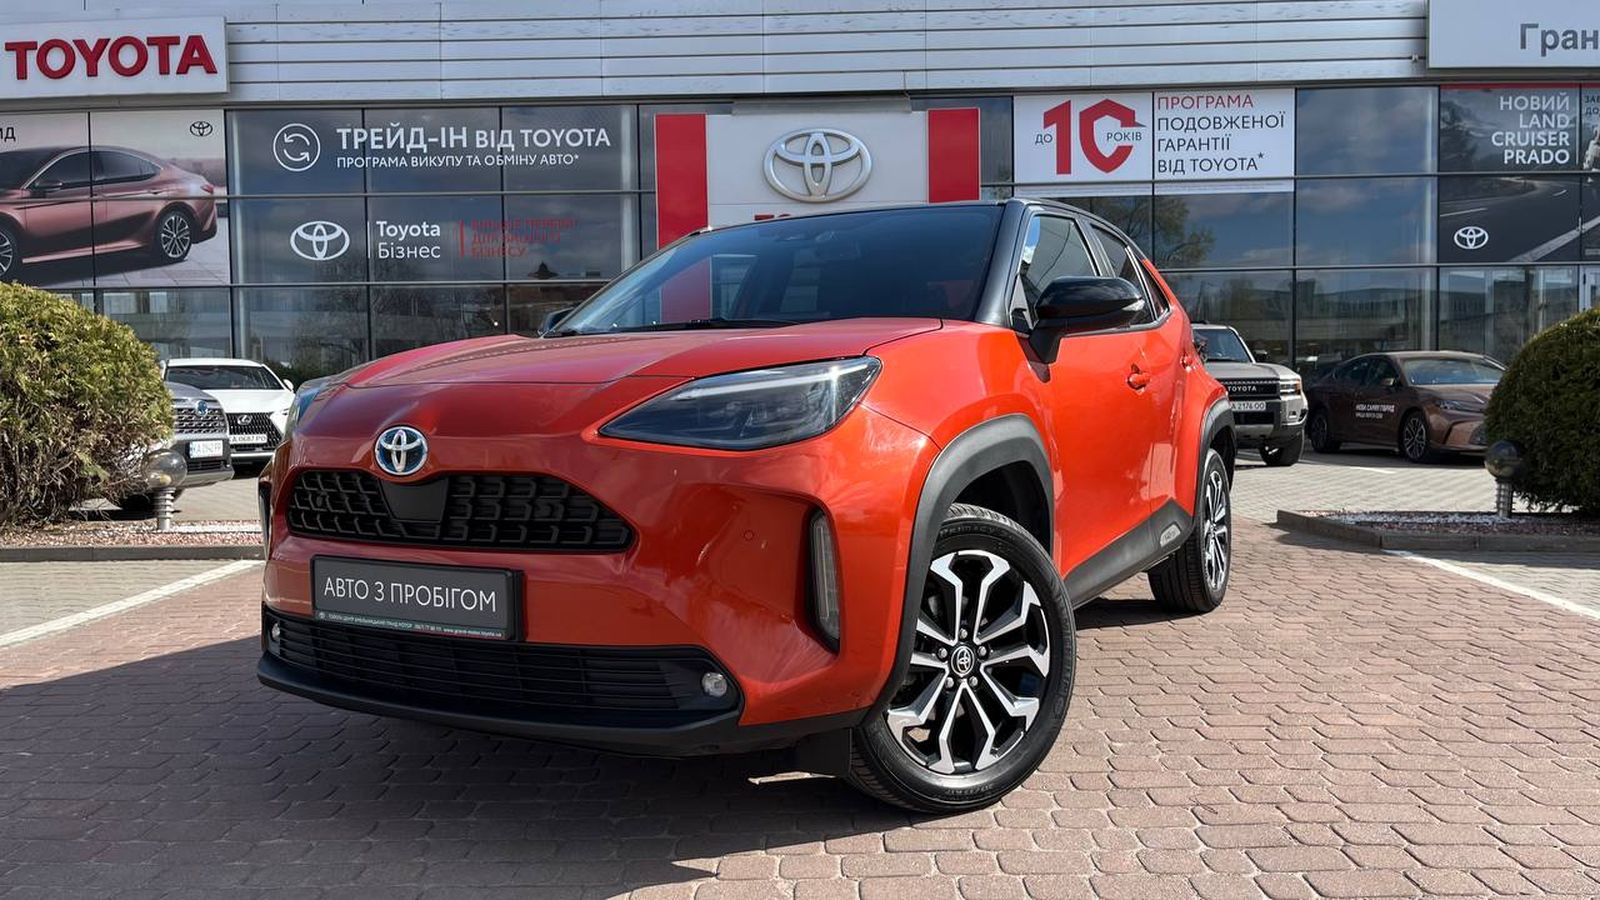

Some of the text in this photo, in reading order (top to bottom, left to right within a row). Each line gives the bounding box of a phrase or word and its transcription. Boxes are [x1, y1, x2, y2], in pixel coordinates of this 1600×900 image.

[1520, 23, 1600, 57] Гран
[5, 35, 218, 80] TOYOTA
[1157, 94, 1253, 110] ПРОГРАМА
[1500, 92, 1570, 111] НОВИЙ
[1157, 111, 1285, 132] ПОДОВЖЕНОЇ
[1519, 113, 1570, 129] LAND
[336, 122, 611, 153] ТРЕЙД-ІН ВІД TOYOTA
[1035, 133, 1053, 145] ДО
[1106, 131, 1143, 143] РОКІВ
[1157, 133, 1232, 152] ГАРАНТІЇ
[1491, 131, 1570, 146] CRUISER
[337, 156, 408, 169] ПРОГРАМА
[411, 155, 464, 168] ВИКУПУ
[465, 155, 482, 167] ТА
[484, 154, 537, 167] ОБМІНУ
[1503, 149, 1570, 165] PRADO
[1157, 159, 1186, 175] ВІД
[376, 221, 441, 241] Toyota
[378, 242, 441, 259] Бізнес
[1228, 385, 1257, 393] TOYOTA
[324, 577, 497, 612] АВТО З ПРОБІГОМ
